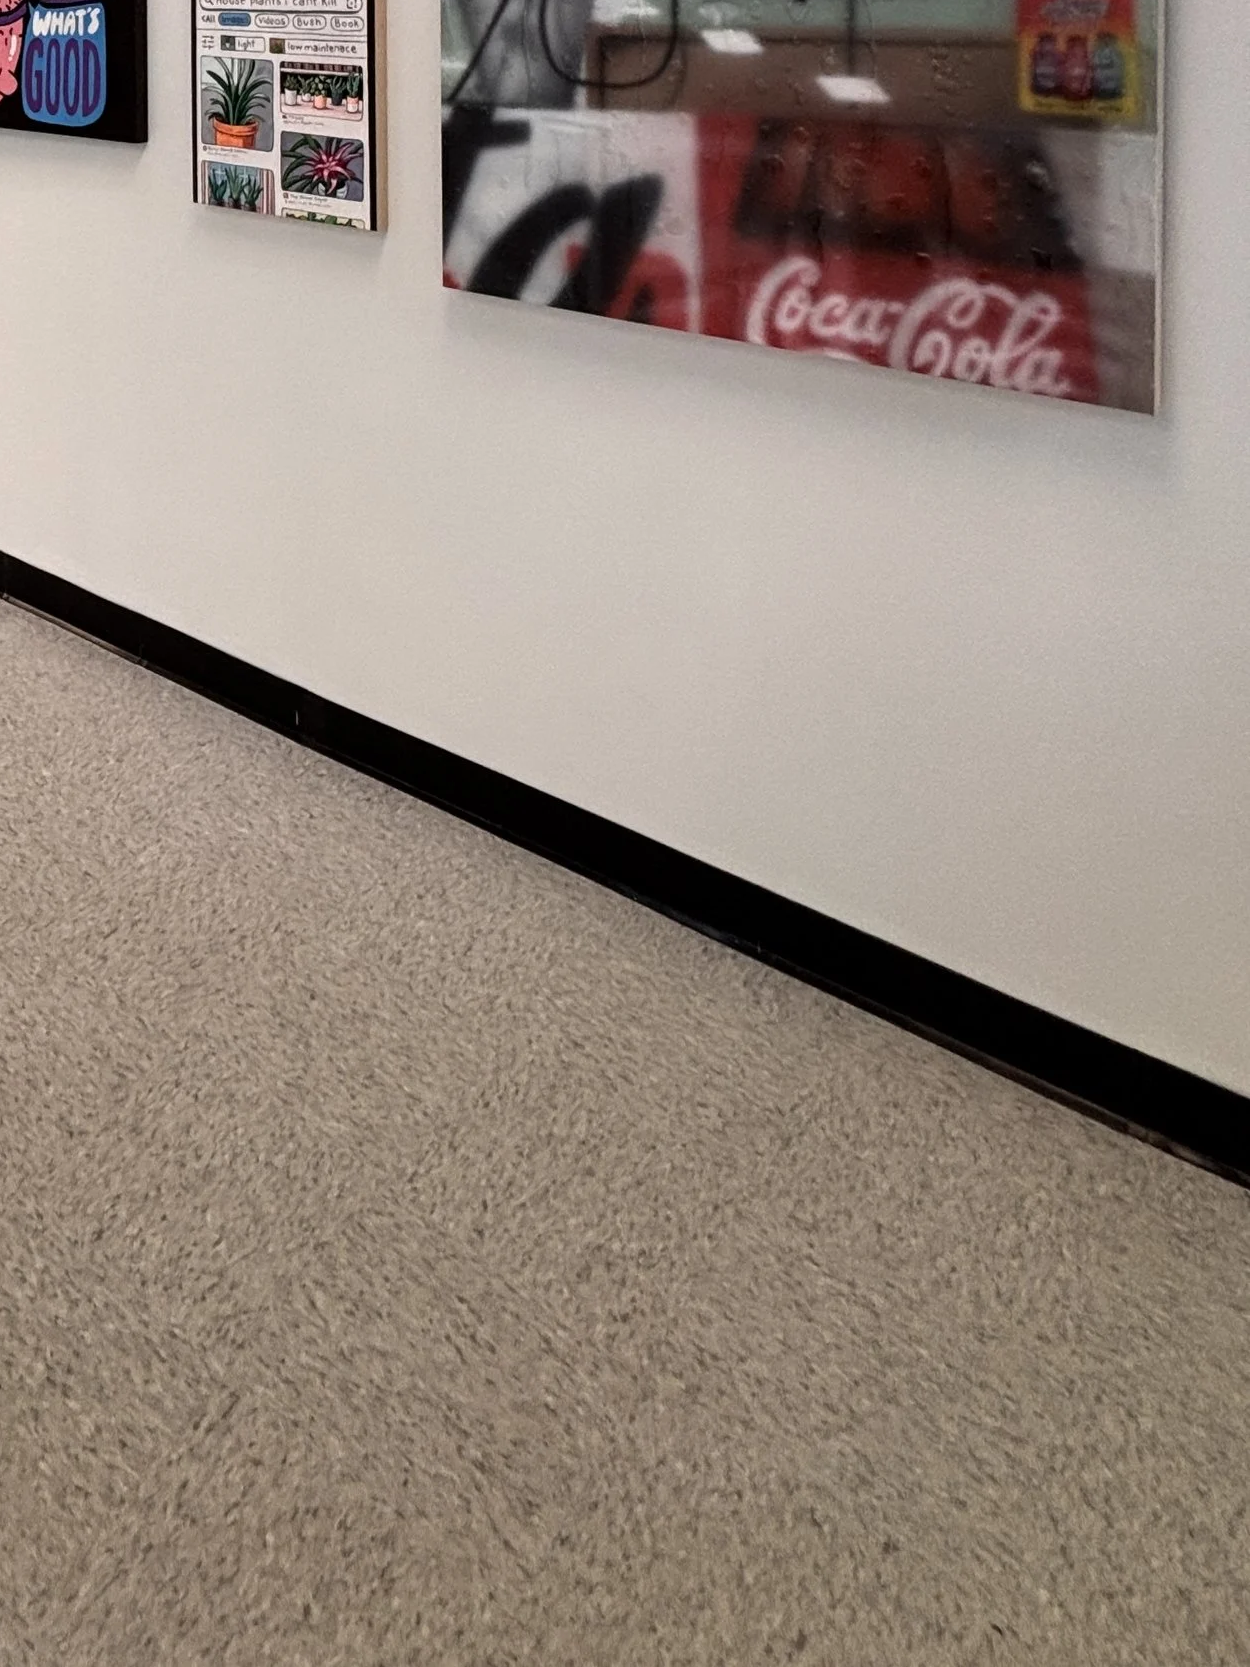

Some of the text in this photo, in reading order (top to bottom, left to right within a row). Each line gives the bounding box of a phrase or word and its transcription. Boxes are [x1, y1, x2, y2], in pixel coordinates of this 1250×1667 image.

[32, 6, 101, 36] WHAT'S
[334, 17, 360, 28] Book
[237, 39, 256, 51] light
[287, 42, 304, 51] low
[25, 37, 102, 117] GOOD
